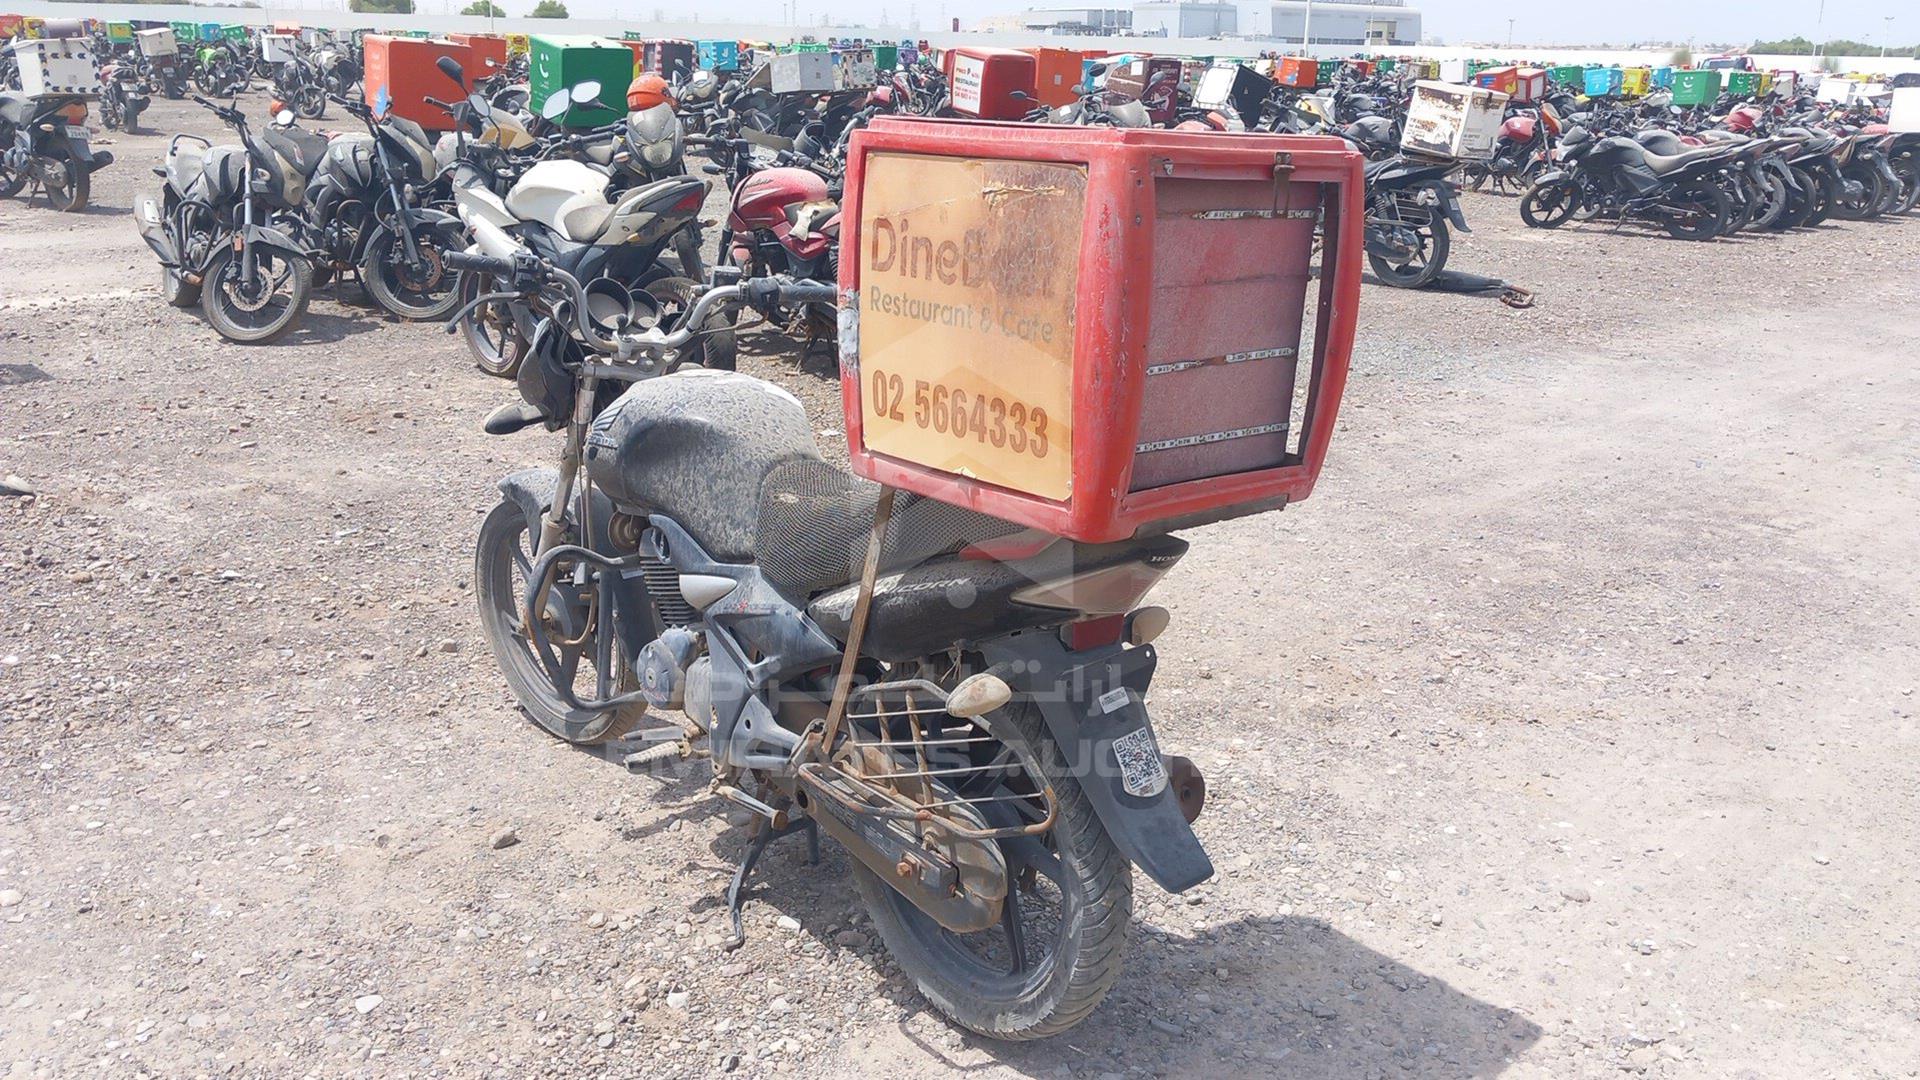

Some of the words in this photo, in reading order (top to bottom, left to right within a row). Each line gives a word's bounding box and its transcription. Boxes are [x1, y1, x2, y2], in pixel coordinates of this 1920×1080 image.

[870, 284, 973, 331] Restaurant
[872, 369, 905, 423] 02
[914, 380, 1050, 459] 5664333
